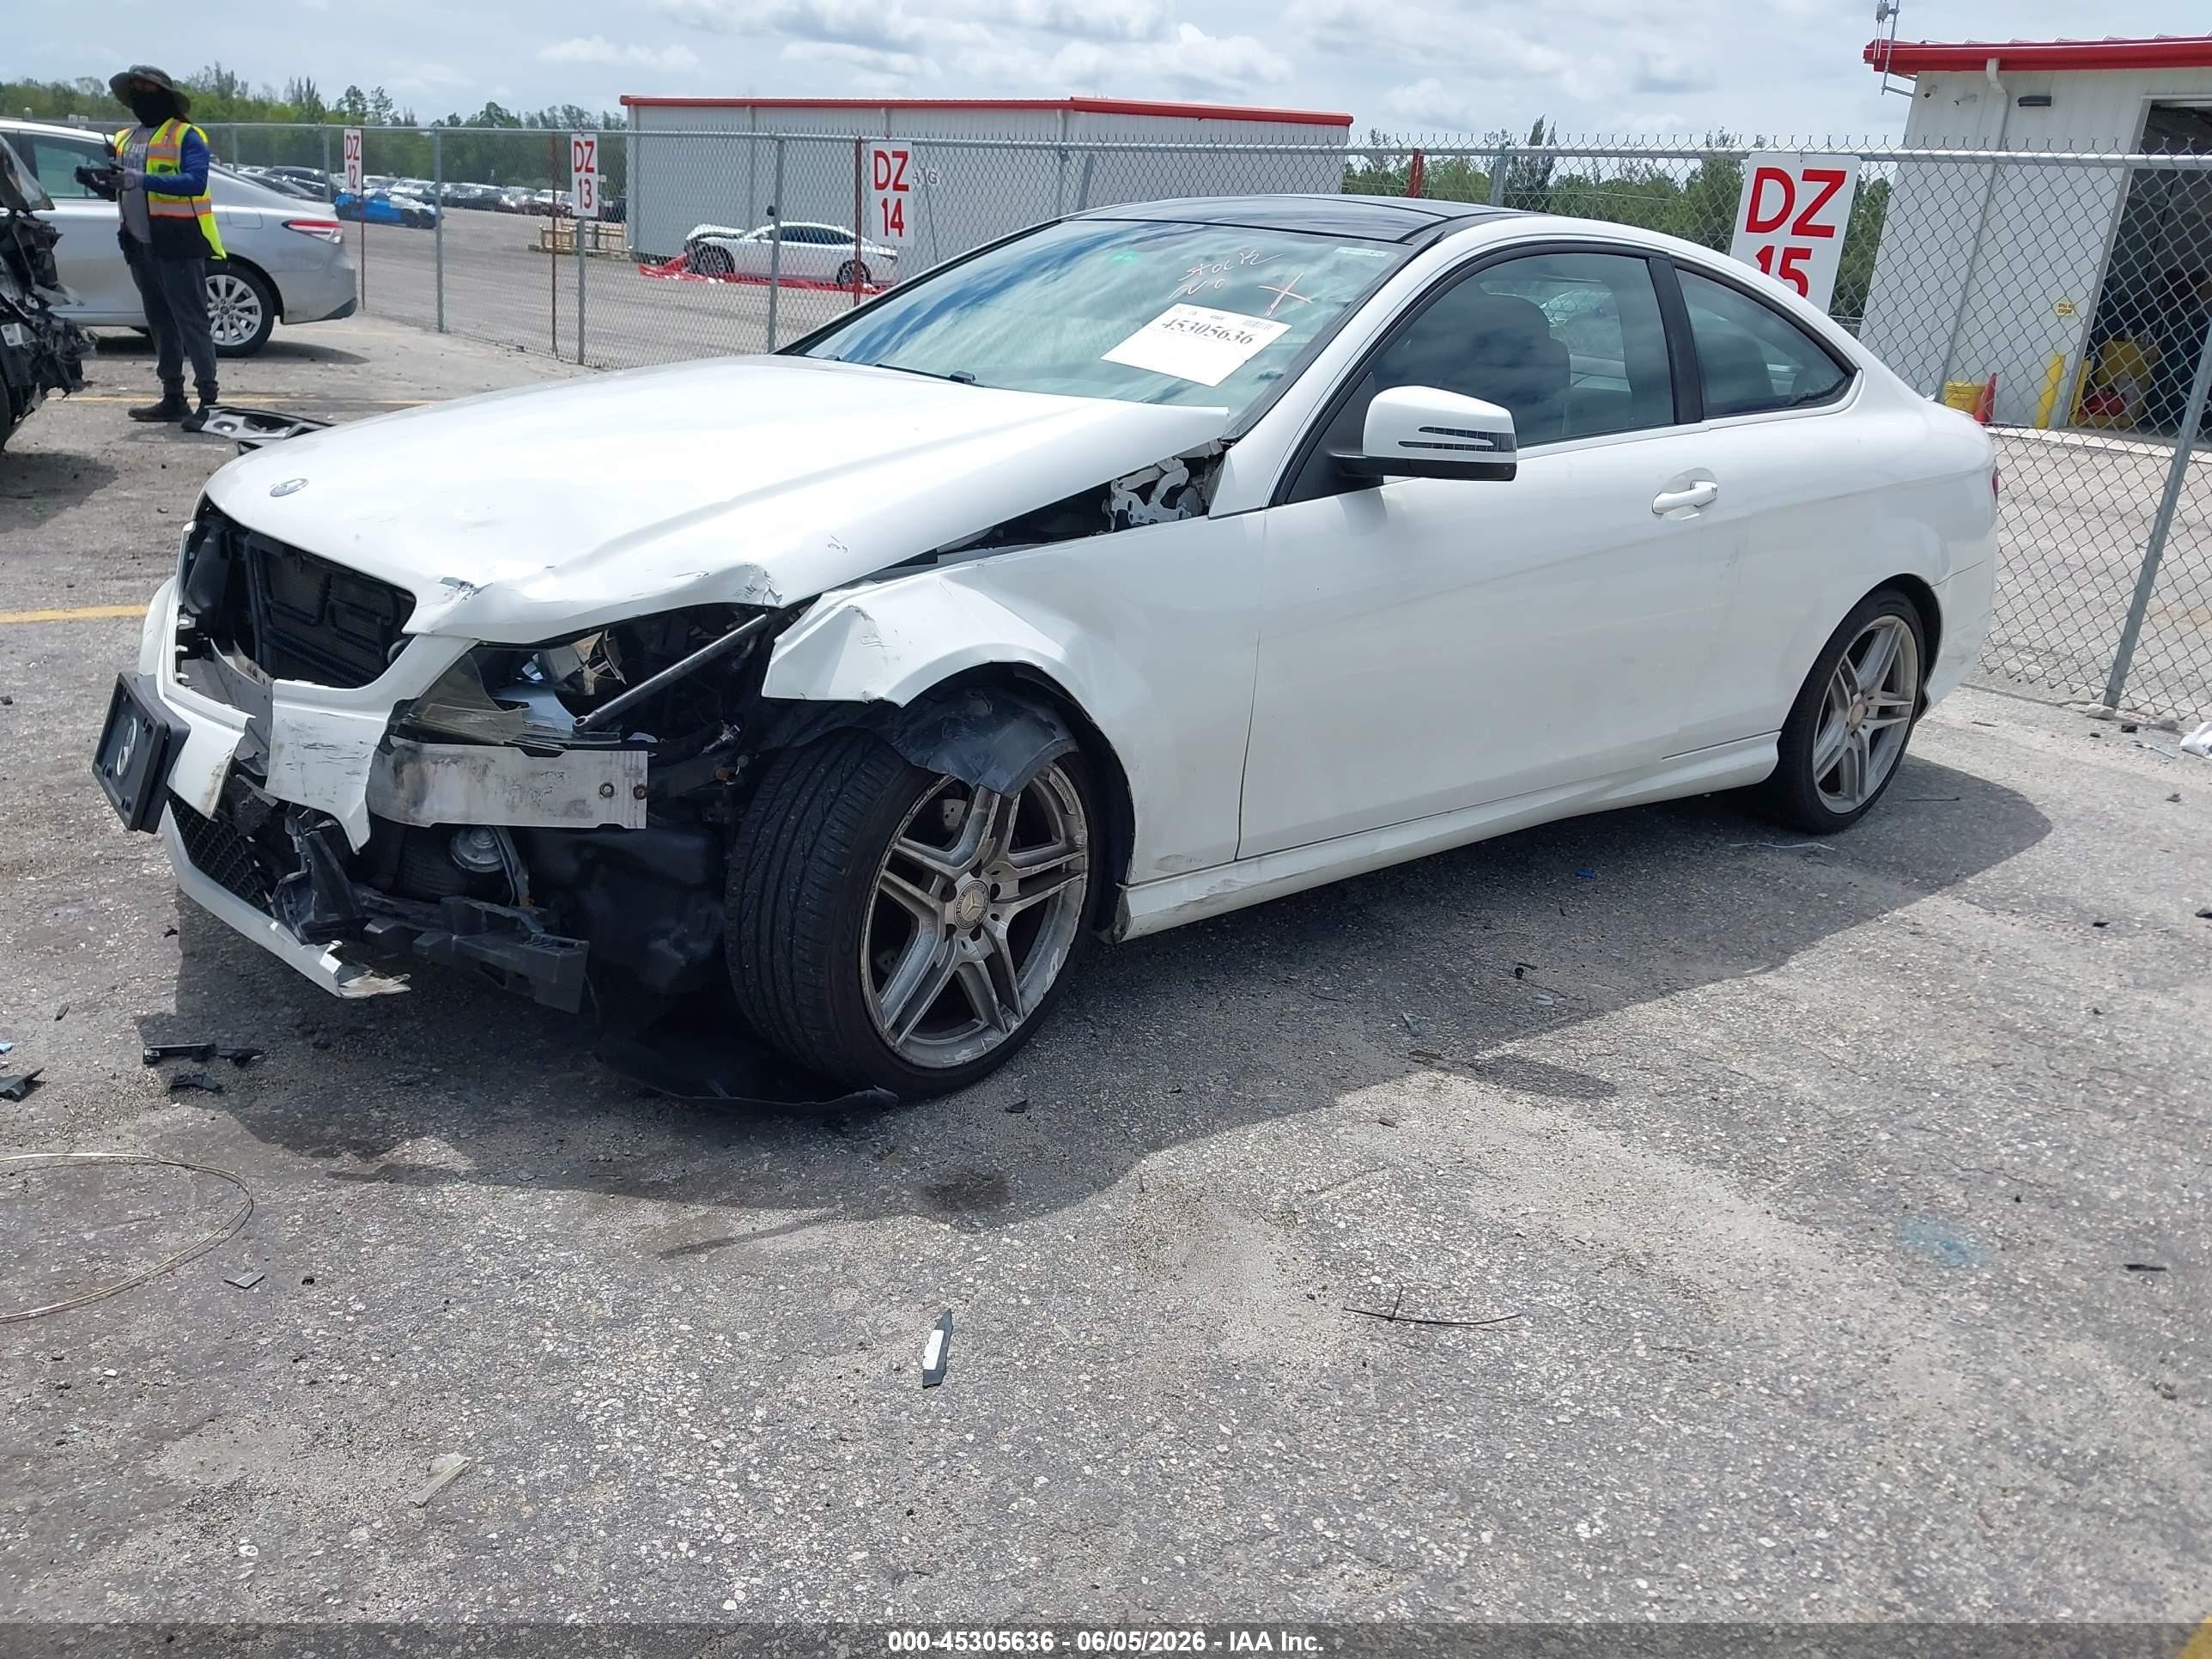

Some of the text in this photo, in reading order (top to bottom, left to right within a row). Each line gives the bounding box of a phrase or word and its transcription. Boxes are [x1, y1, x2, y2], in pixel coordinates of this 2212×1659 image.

[346, 134, 360, 161] DZ
[574, 140, 595, 173] DZ
[348, 164, 357, 189] 12
[873, 150, 909, 191] DZ
[578, 178, 592, 209] 13
[1745, 167, 1847, 238] DZ
[881, 198, 905, 238] 14
[1161, 318, 1257, 344] 45305636
